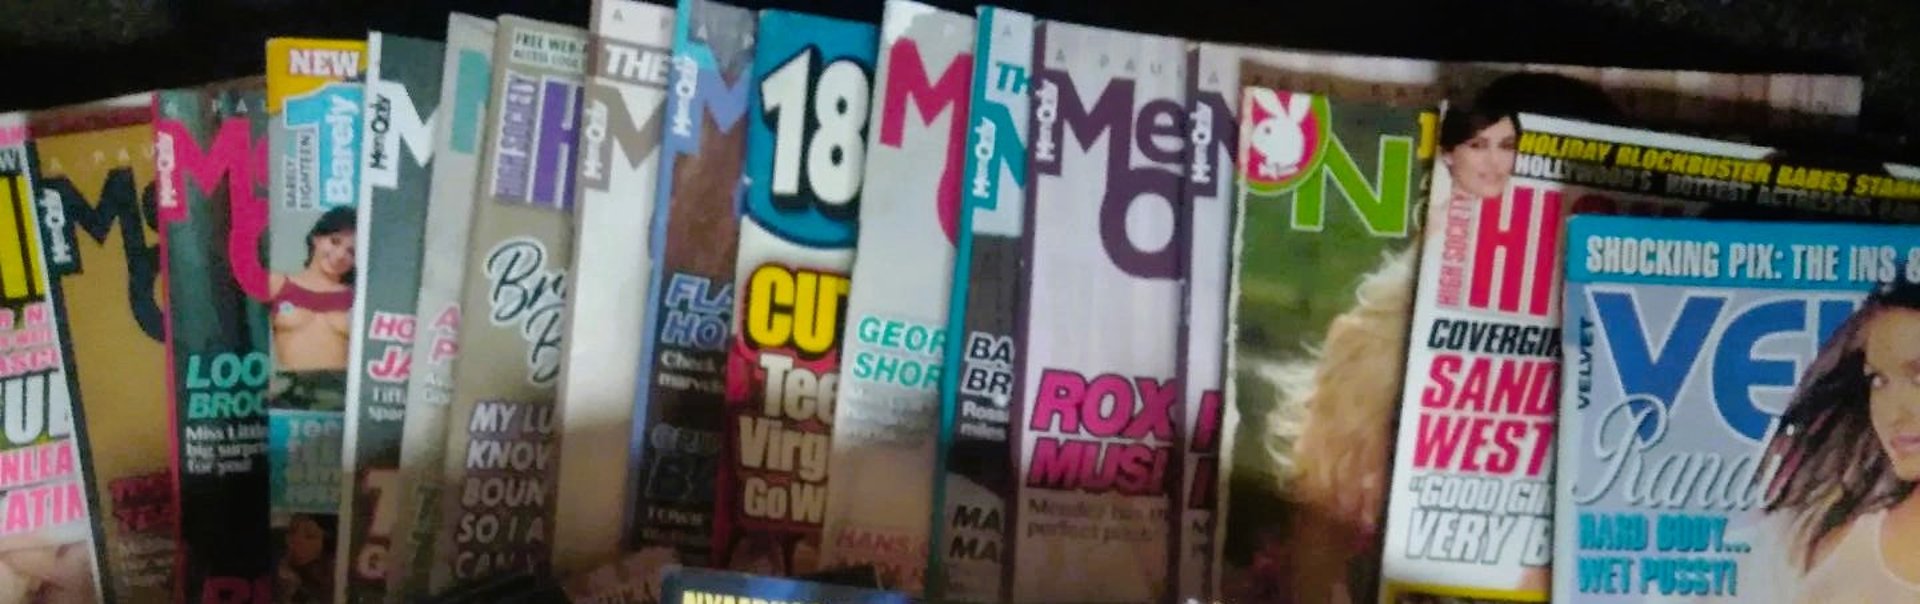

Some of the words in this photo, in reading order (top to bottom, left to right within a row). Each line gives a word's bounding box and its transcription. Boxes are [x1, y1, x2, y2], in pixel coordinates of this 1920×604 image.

[290, 48, 360, 77] NEW
[325, 94, 359, 204] Barely
[761, 48, 868, 207] 18
[1518, 132, 1613, 164] HOLIDAY
[1614, 148, 1772, 186] BLOCKBUSTER
[1776, 165, 1851, 194] BABES
[1586, 235, 1720, 277] SHOCKING
[1728, 245, 1784, 278] PIX:
[1791, 246, 1839, 281] THE
[1850, 246, 1898, 284] INS
[1577, 316, 1596, 409] VELVET
[469, 403, 517, 433] MY
[739, 416, 828, 484] Virg
[743, 477, 789, 520] Go
[456, 514, 499, 545] SO
[1404, 512, 1508, 562] VERY
[1577, 512, 1651, 551] HARD
[1577, 556, 1635, 594] WET
